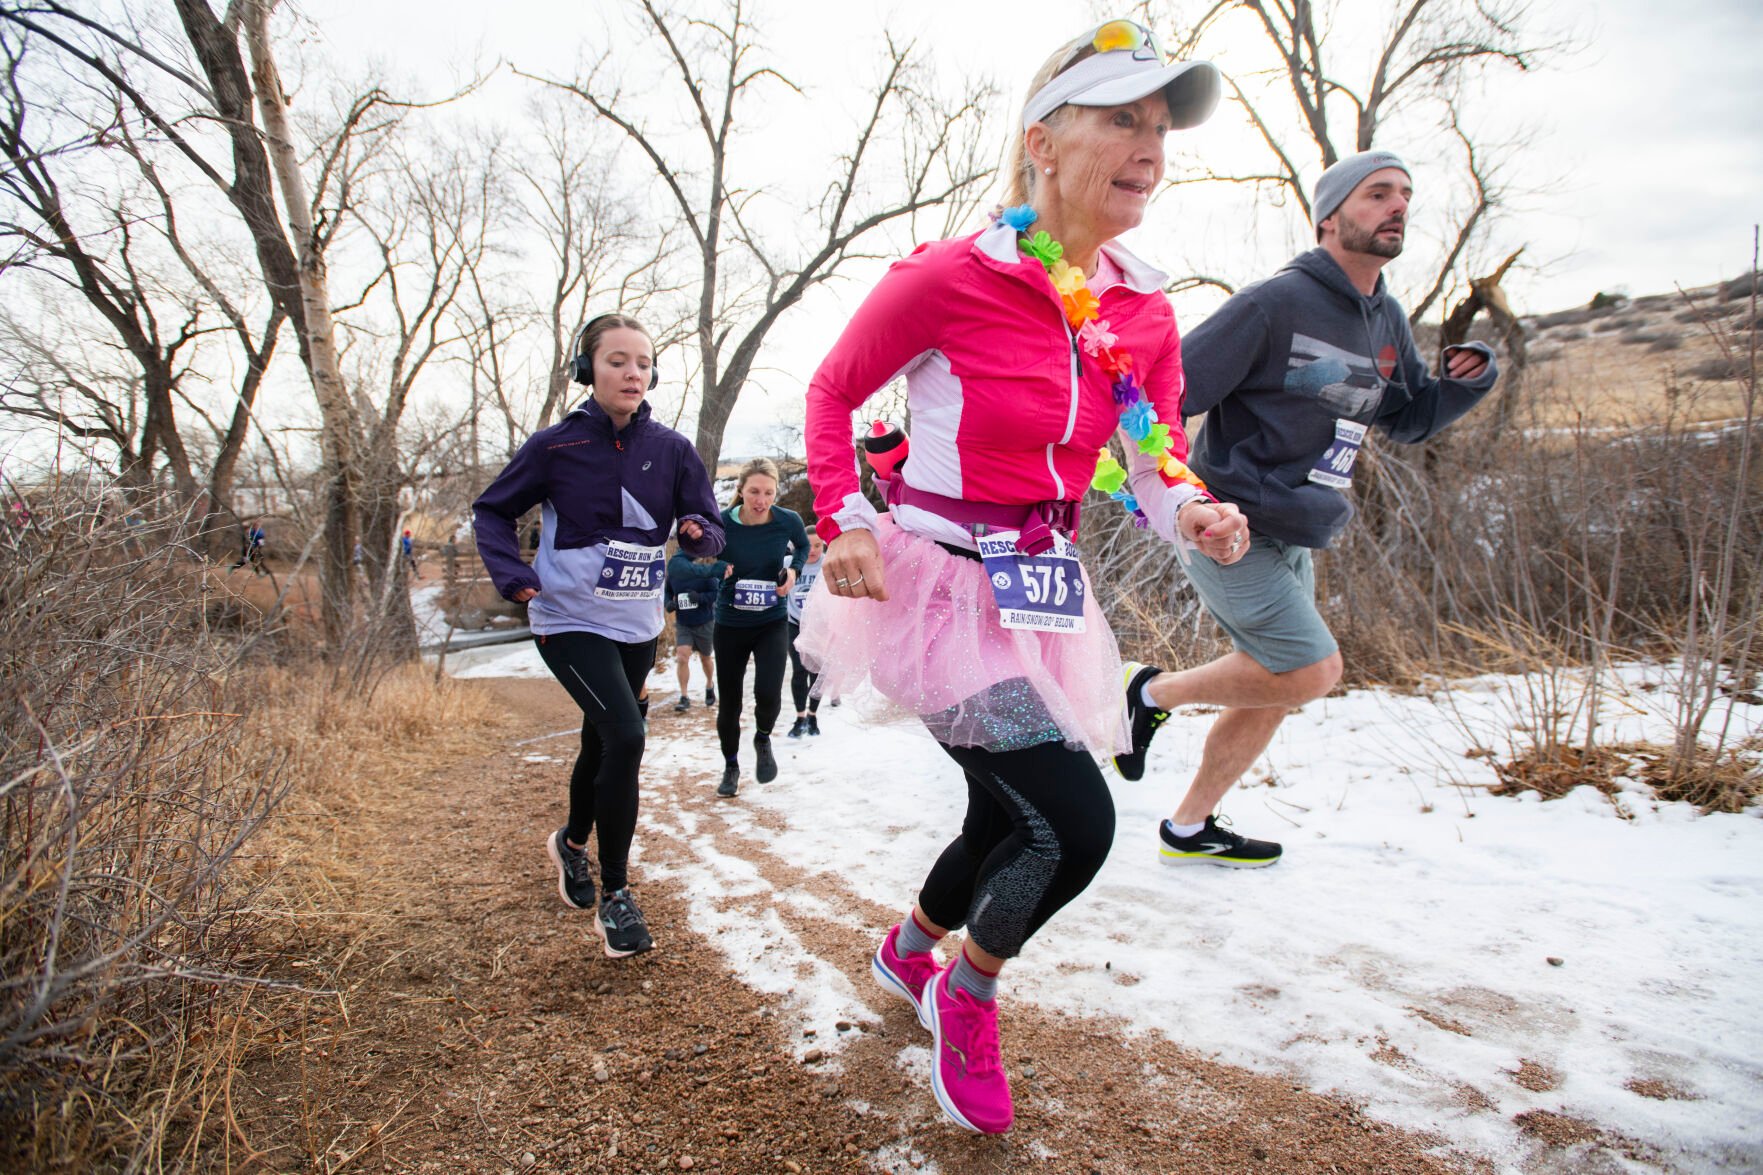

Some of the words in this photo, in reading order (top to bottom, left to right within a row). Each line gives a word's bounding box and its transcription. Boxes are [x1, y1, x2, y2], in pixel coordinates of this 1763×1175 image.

[607, 546, 638, 561] RESCUE
[638, 552, 652, 561] RUN
[979, 541, 1016, 555] RESC
[1064, 541, 1080, 559] 202
[1018, 564, 1068, 606] 576
[744, 591, 766, 605] 361
[1054, 617, 1075, 629] BELOW
